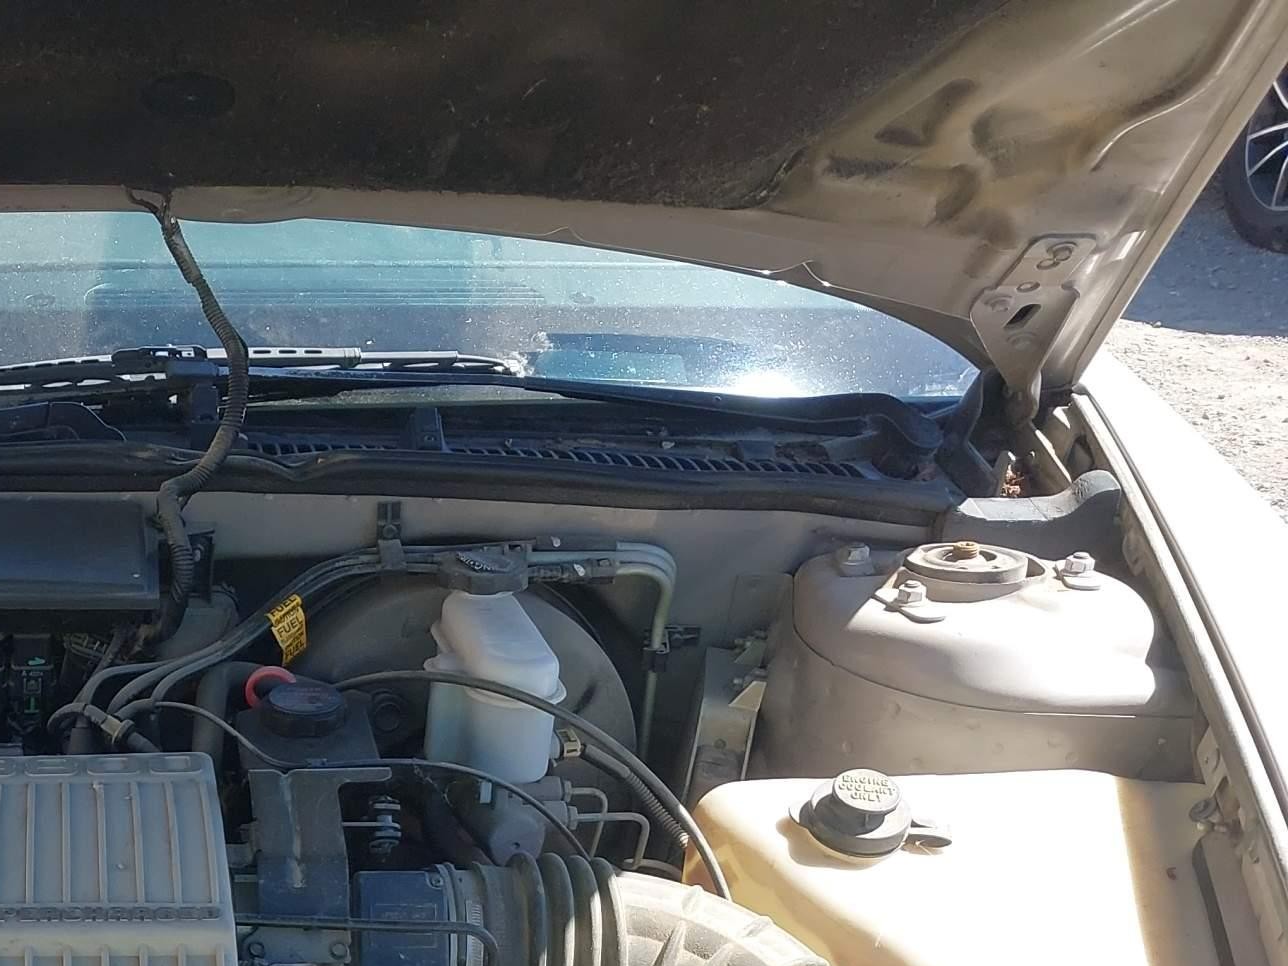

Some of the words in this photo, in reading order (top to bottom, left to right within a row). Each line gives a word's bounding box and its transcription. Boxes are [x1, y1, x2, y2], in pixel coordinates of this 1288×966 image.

[270, 597, 298, 618] FUEL
[277, 616, 304, 638] FUEL
[842, 774, 890, 788] ENGINE
[838, 782, 896, 797] COOLANT
[850, 791, 882, 803] ONLY
